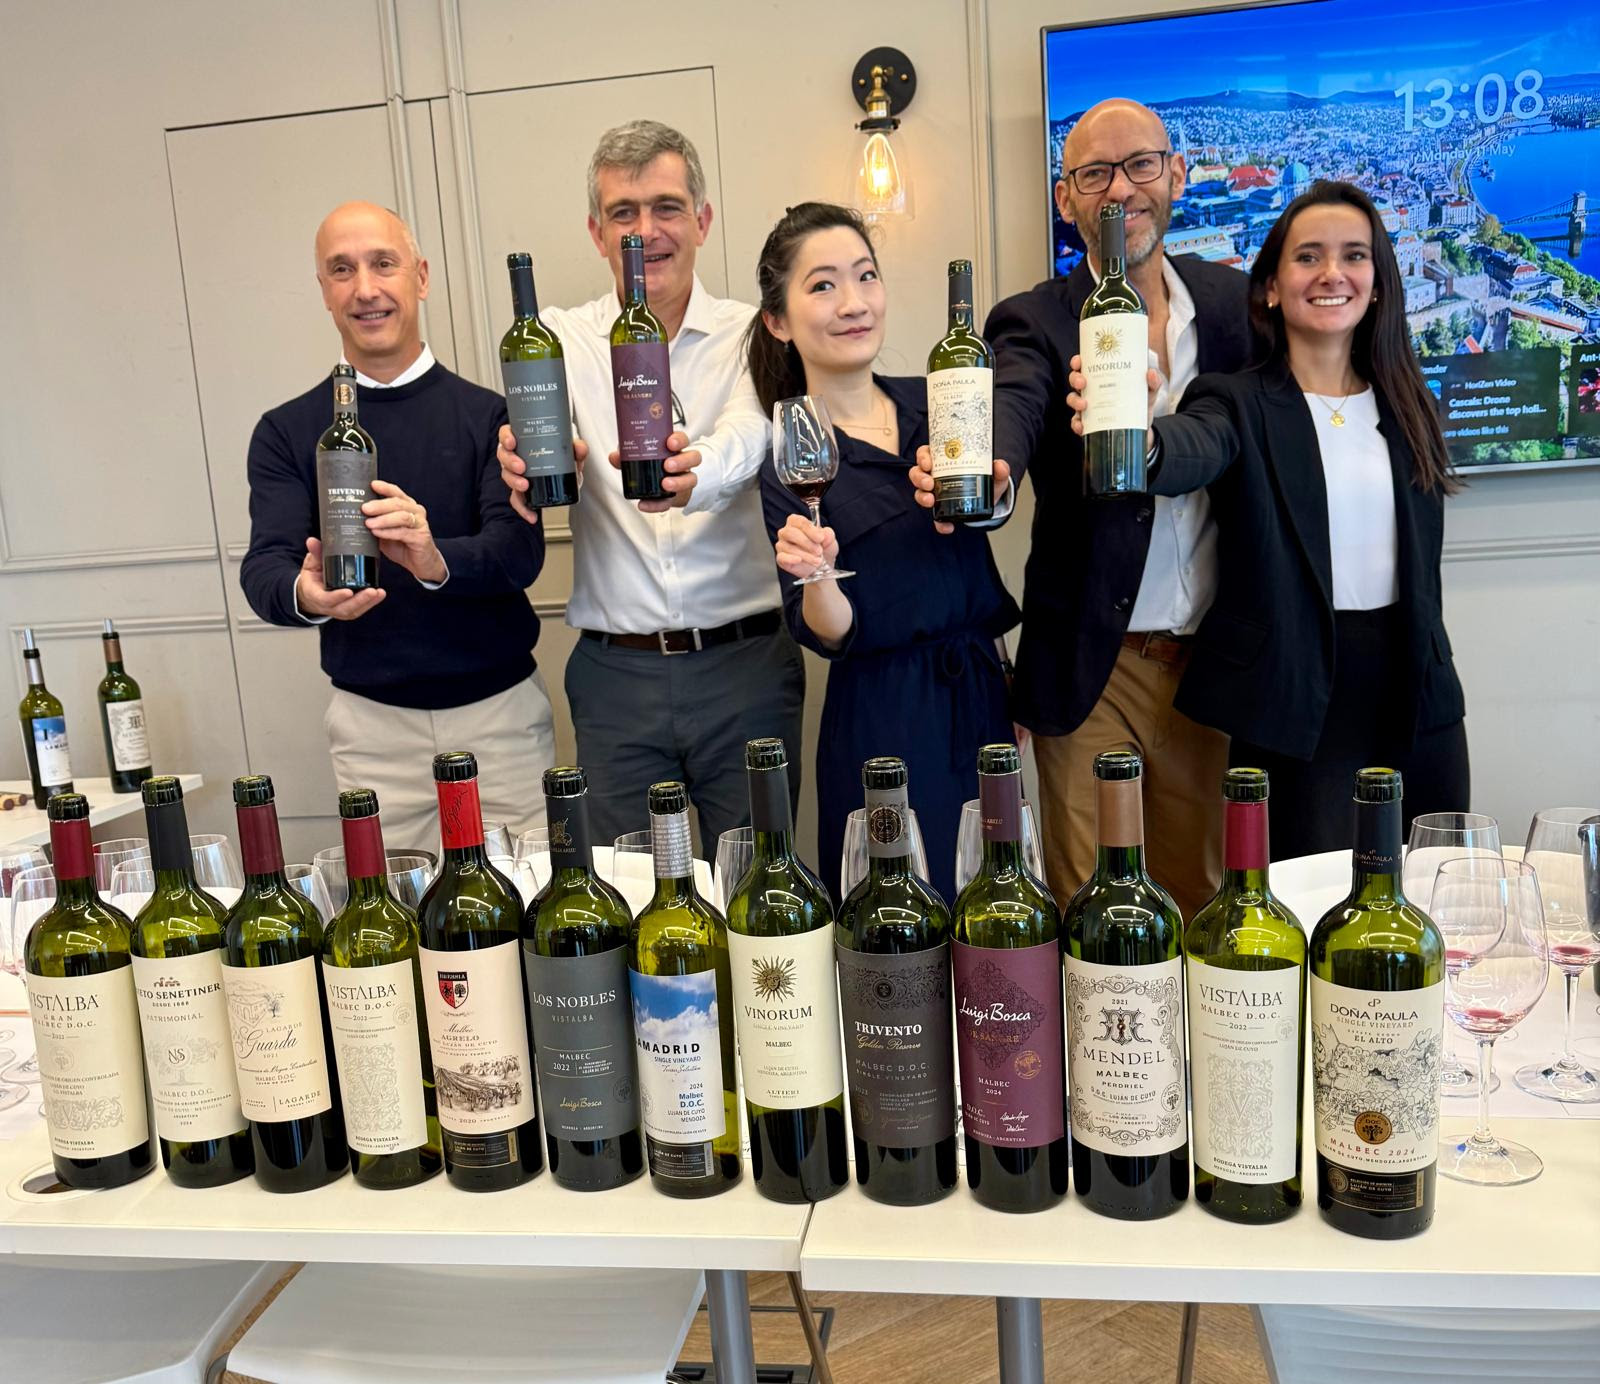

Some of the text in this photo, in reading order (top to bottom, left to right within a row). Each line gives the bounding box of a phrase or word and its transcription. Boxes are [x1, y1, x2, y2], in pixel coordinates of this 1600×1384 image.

[1394, 69, 1544, 132] 13:08
[1421, 147, 1472, 162] Monday
[1489, 144, 1516, 157] May
[1088, 361, 1132, 373] VINORUM
[508, 382, 558, 394] LOS NOBLES
[618, 374, 658, 392] Luigi Bosca
[1494, 379, 1517, 387] Video
[1484, 396, 1511, 404] Drone
[1448, 409, 1488, 420] discovers
[1490, 408, 1504, 416] the
[1506, 406, 1520, 416] top
[1442, 426, 1509, 438] ore videos like this
[328, 488, 366, 496] TRIVENTO
[156, 982, 221, 1000] SENETINER
[330, 984, 397, 1000] VISTALBA
[1200, 984, 1282, 1007] VISTALBA
[30, 992, 99, 1012] ISTALBA
[533, 990, 616, 1008] LOS NOBLES
[332, 1001, 396, 1010] MALBEC D.O.C.
[960, 996, 1032, 1026] Luigi Bosca
[1200, 1003, 1280, 1020] MALBEC D.O.C.
[146, 1012, 204, 1022] PATRIMONIAL
[744, 1005, 813, 1021] VINORUM
[1330, 1003, 1419, 1021] DOÑA PAULA
[67, 1020, 96, 1029] D.O.C.
[552, 1014, 594, 1023] VISTALBA
[1336, 1016, 1366, 1027] SINGLE
[266, 1022, 302, 1034] LAGARDE
[854, 1020, 922, 1036] TRIVENTO
[1229, 1022, 1248, 1031] 2022
[856, 1034, 922, 1050] Golden Reserve
[1354, 1034, 1366, 1042] EL
[244, 1029, 298, 1060] Guarda
[637, 1038, 700, 1054] AMADRID
[560, 1052, 592, 1060] MALBEC
[672, 1056, 702, 1064] VINEYARD
[1083, 1046, 1165, 1065] MENDEL
[553, 1062, 570, 1072] 2022
[856, 1058, 930, 1072] MALBEC D.O.C.
[856, 1068, 928, 1080] SINGLE VINEYARD
[1096, 1070, 1149, 1080] MALBEC
[978, 1077, 1010, 1088] MALBEC
[1102, 1081, 1144, 1089] PERDRIEL
[278, 1090, 322, 1105] LAGARDE
[678, 1092, 704, 1100] Malbec
[1140, 1090, 1156, 1100] CUYO
[560, 1096, 602, 1112] Luigi Bosca
[680, 1099, 704, 1108] D.O.C.
[1330, 1138, 1380, 1156] MALBEC
[1214, 1156, 1236, 1168] BODEGA
